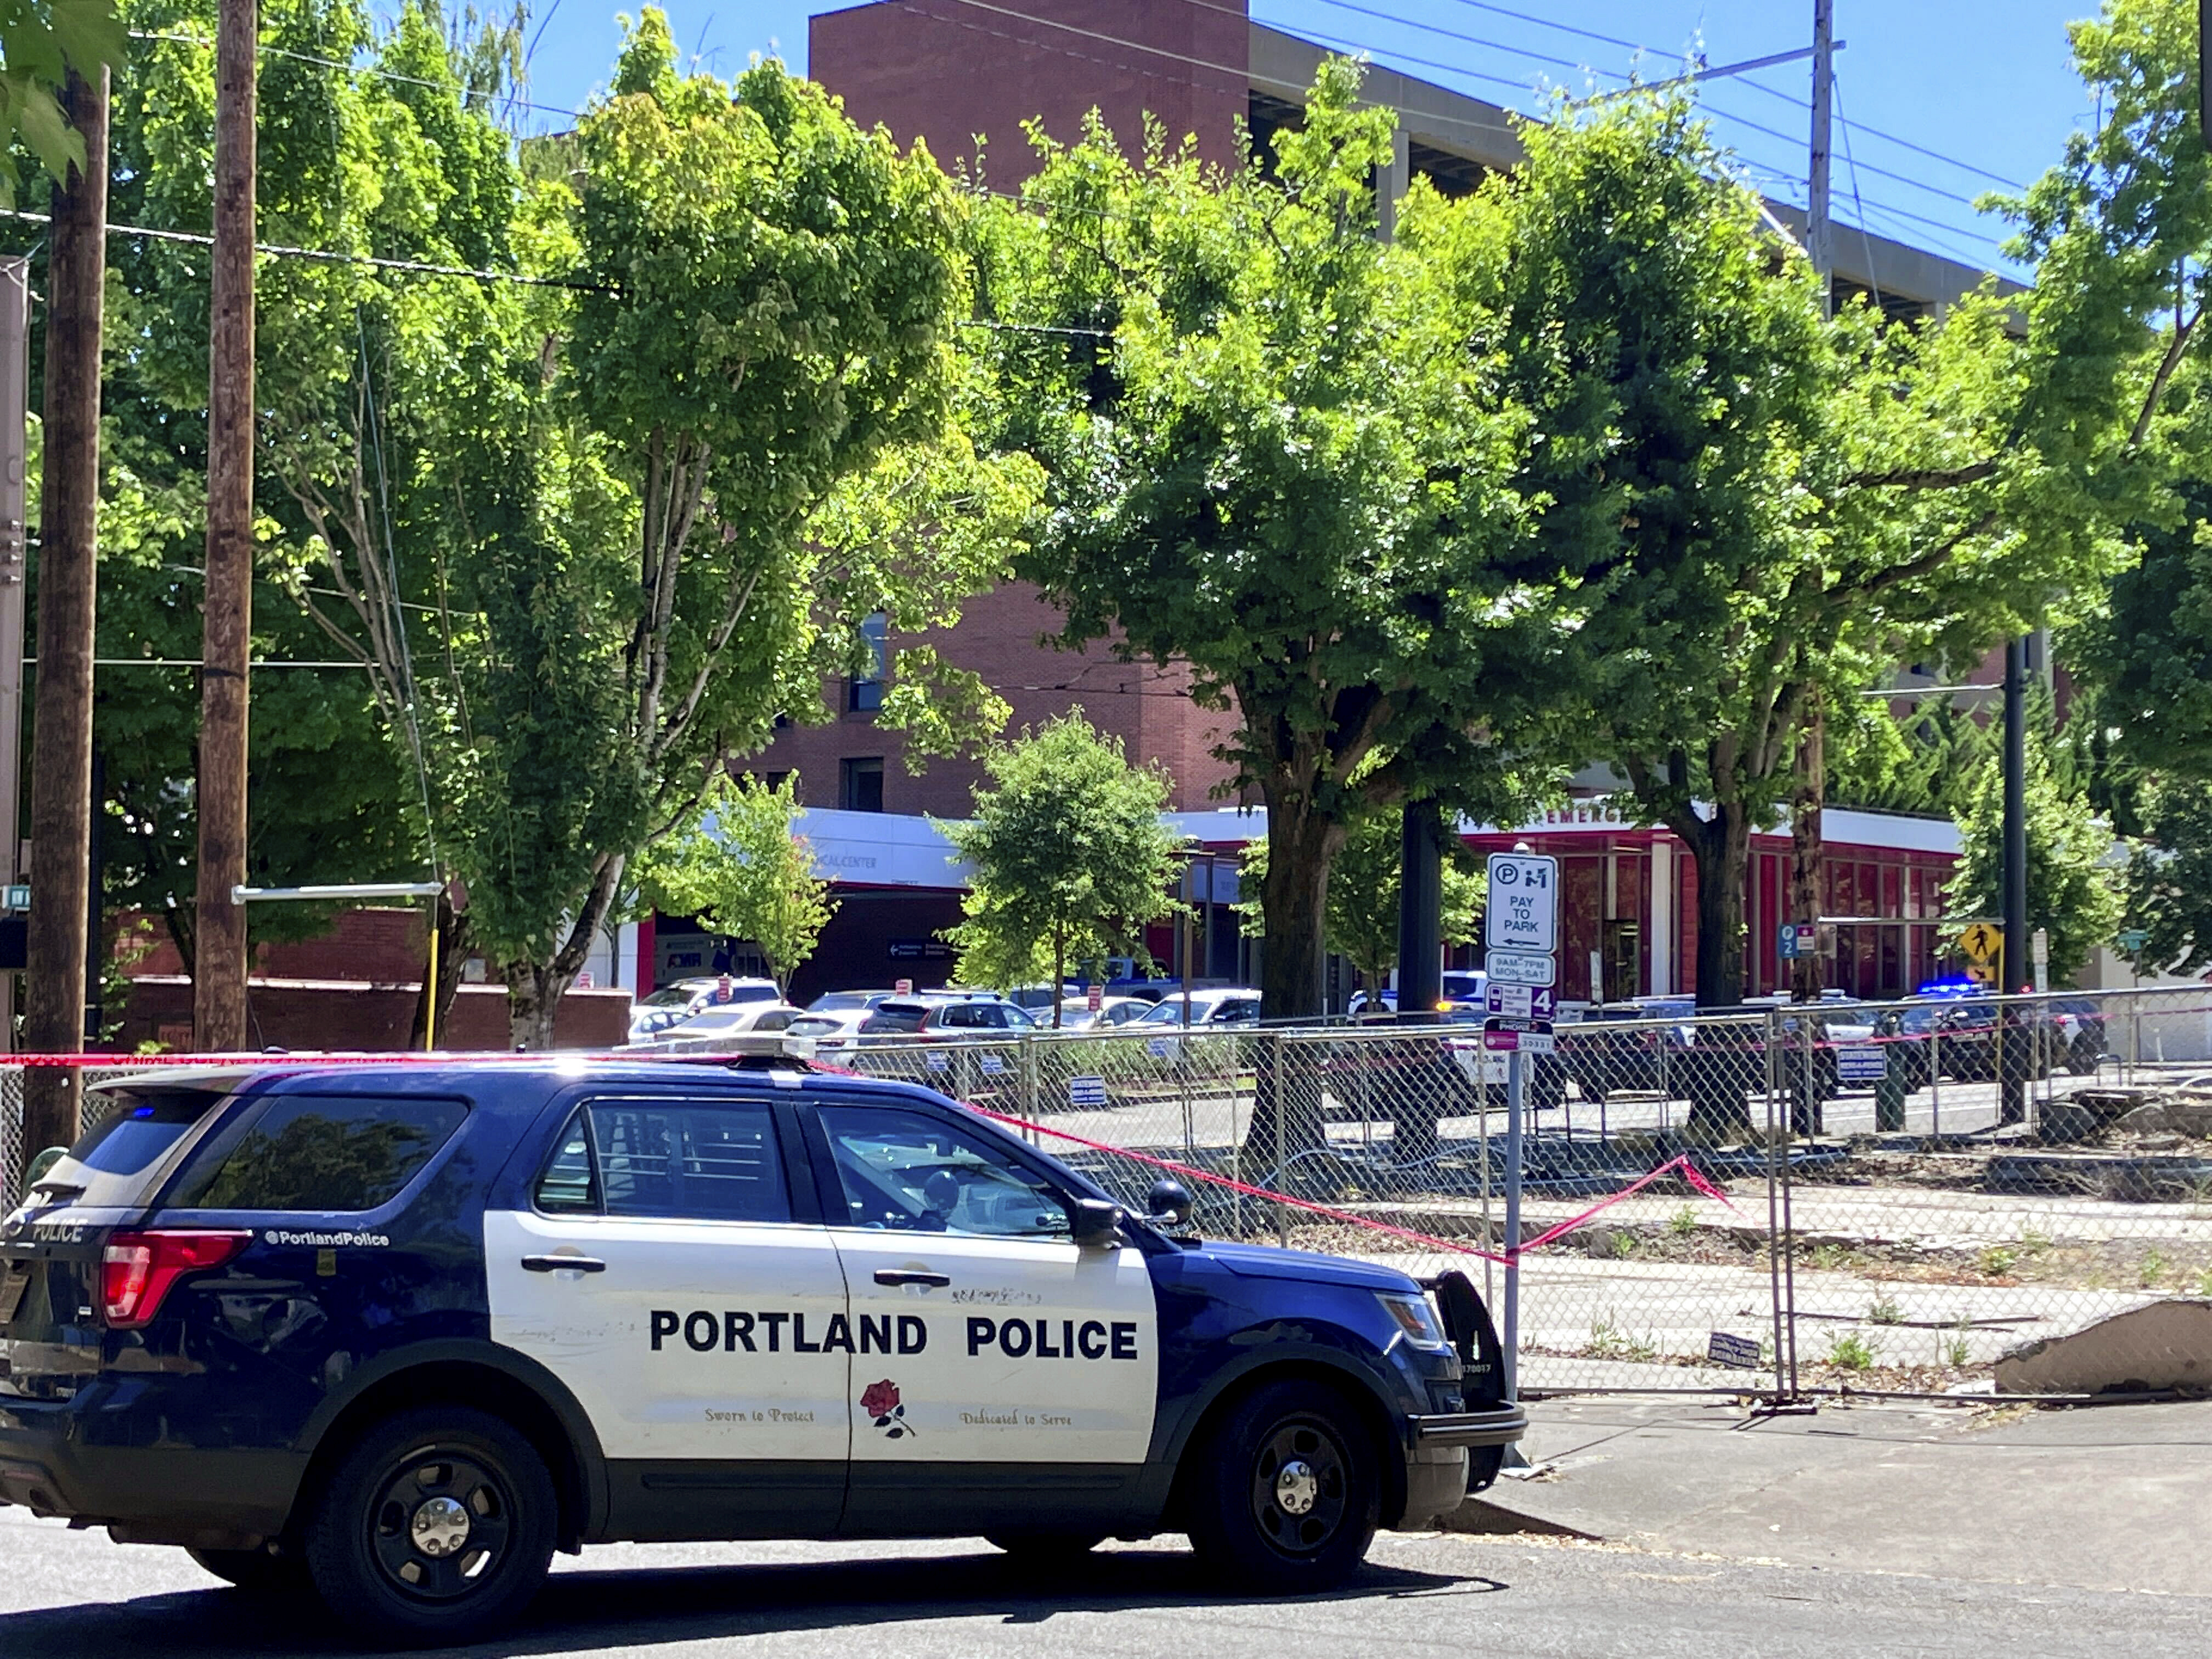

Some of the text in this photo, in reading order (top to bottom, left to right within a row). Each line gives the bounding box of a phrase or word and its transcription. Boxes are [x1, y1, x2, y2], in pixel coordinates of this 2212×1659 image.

[841, 855, 876, 868] CENTER
[1510, 895, 1534, 907] PAY
[1513, 909, 1530, 919] TO
[1504, 919, 1539, 932] PARK
[1784, 941, 1792, 953] 2
[1533, 990, 1552, 1012] 4
[32, 1218, 88, 1243] POLICE
[266, 1231, 390, 1246] @PortlandPolice
[651, 1310, 1138, 1360] PORTLAND POLICE
[704, 1408, 815, 1422] Sworn to Protect
[959, 1408, 1071, 1426] Dedicated to Serve
